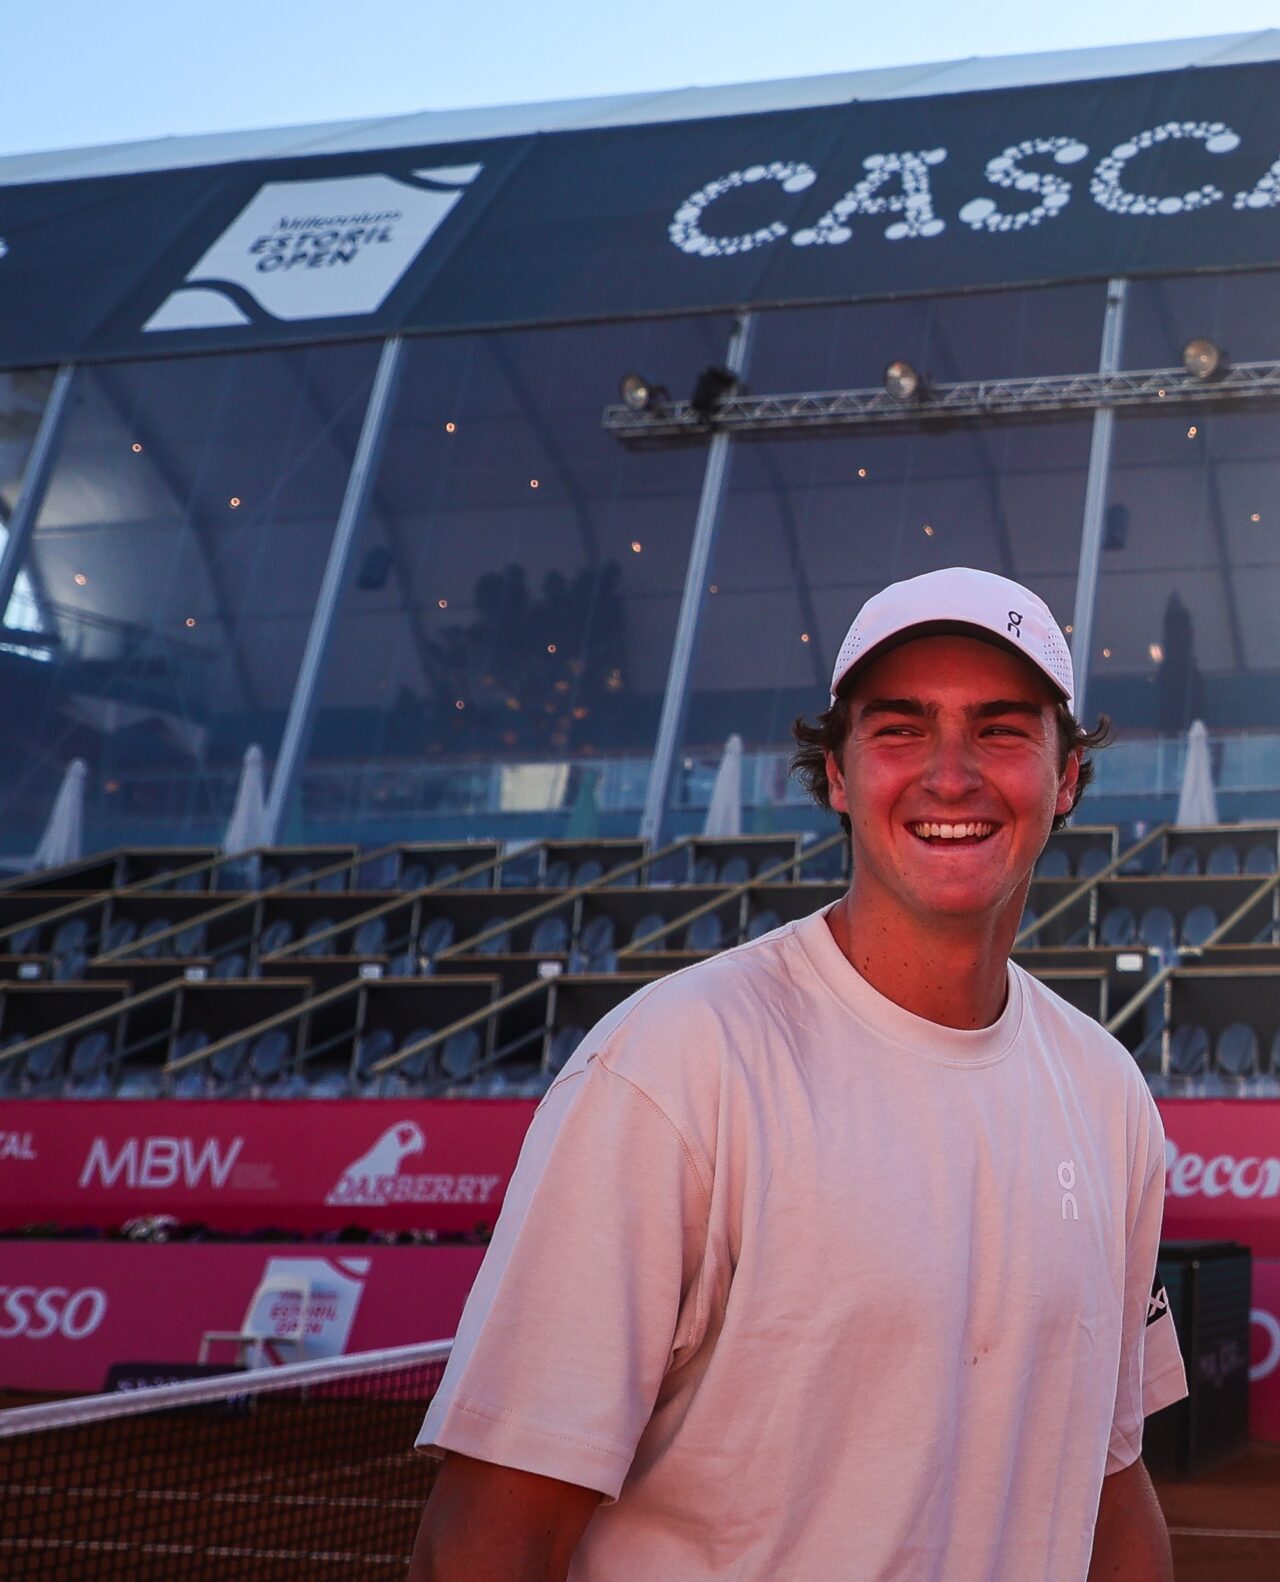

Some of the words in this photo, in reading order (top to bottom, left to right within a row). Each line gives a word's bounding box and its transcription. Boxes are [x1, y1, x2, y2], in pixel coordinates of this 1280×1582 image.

[249, 226, 393, 254] ESTORIL
[256, 247, 359, 273] OPEN
[79, 1136, 244, 1188] MBW
